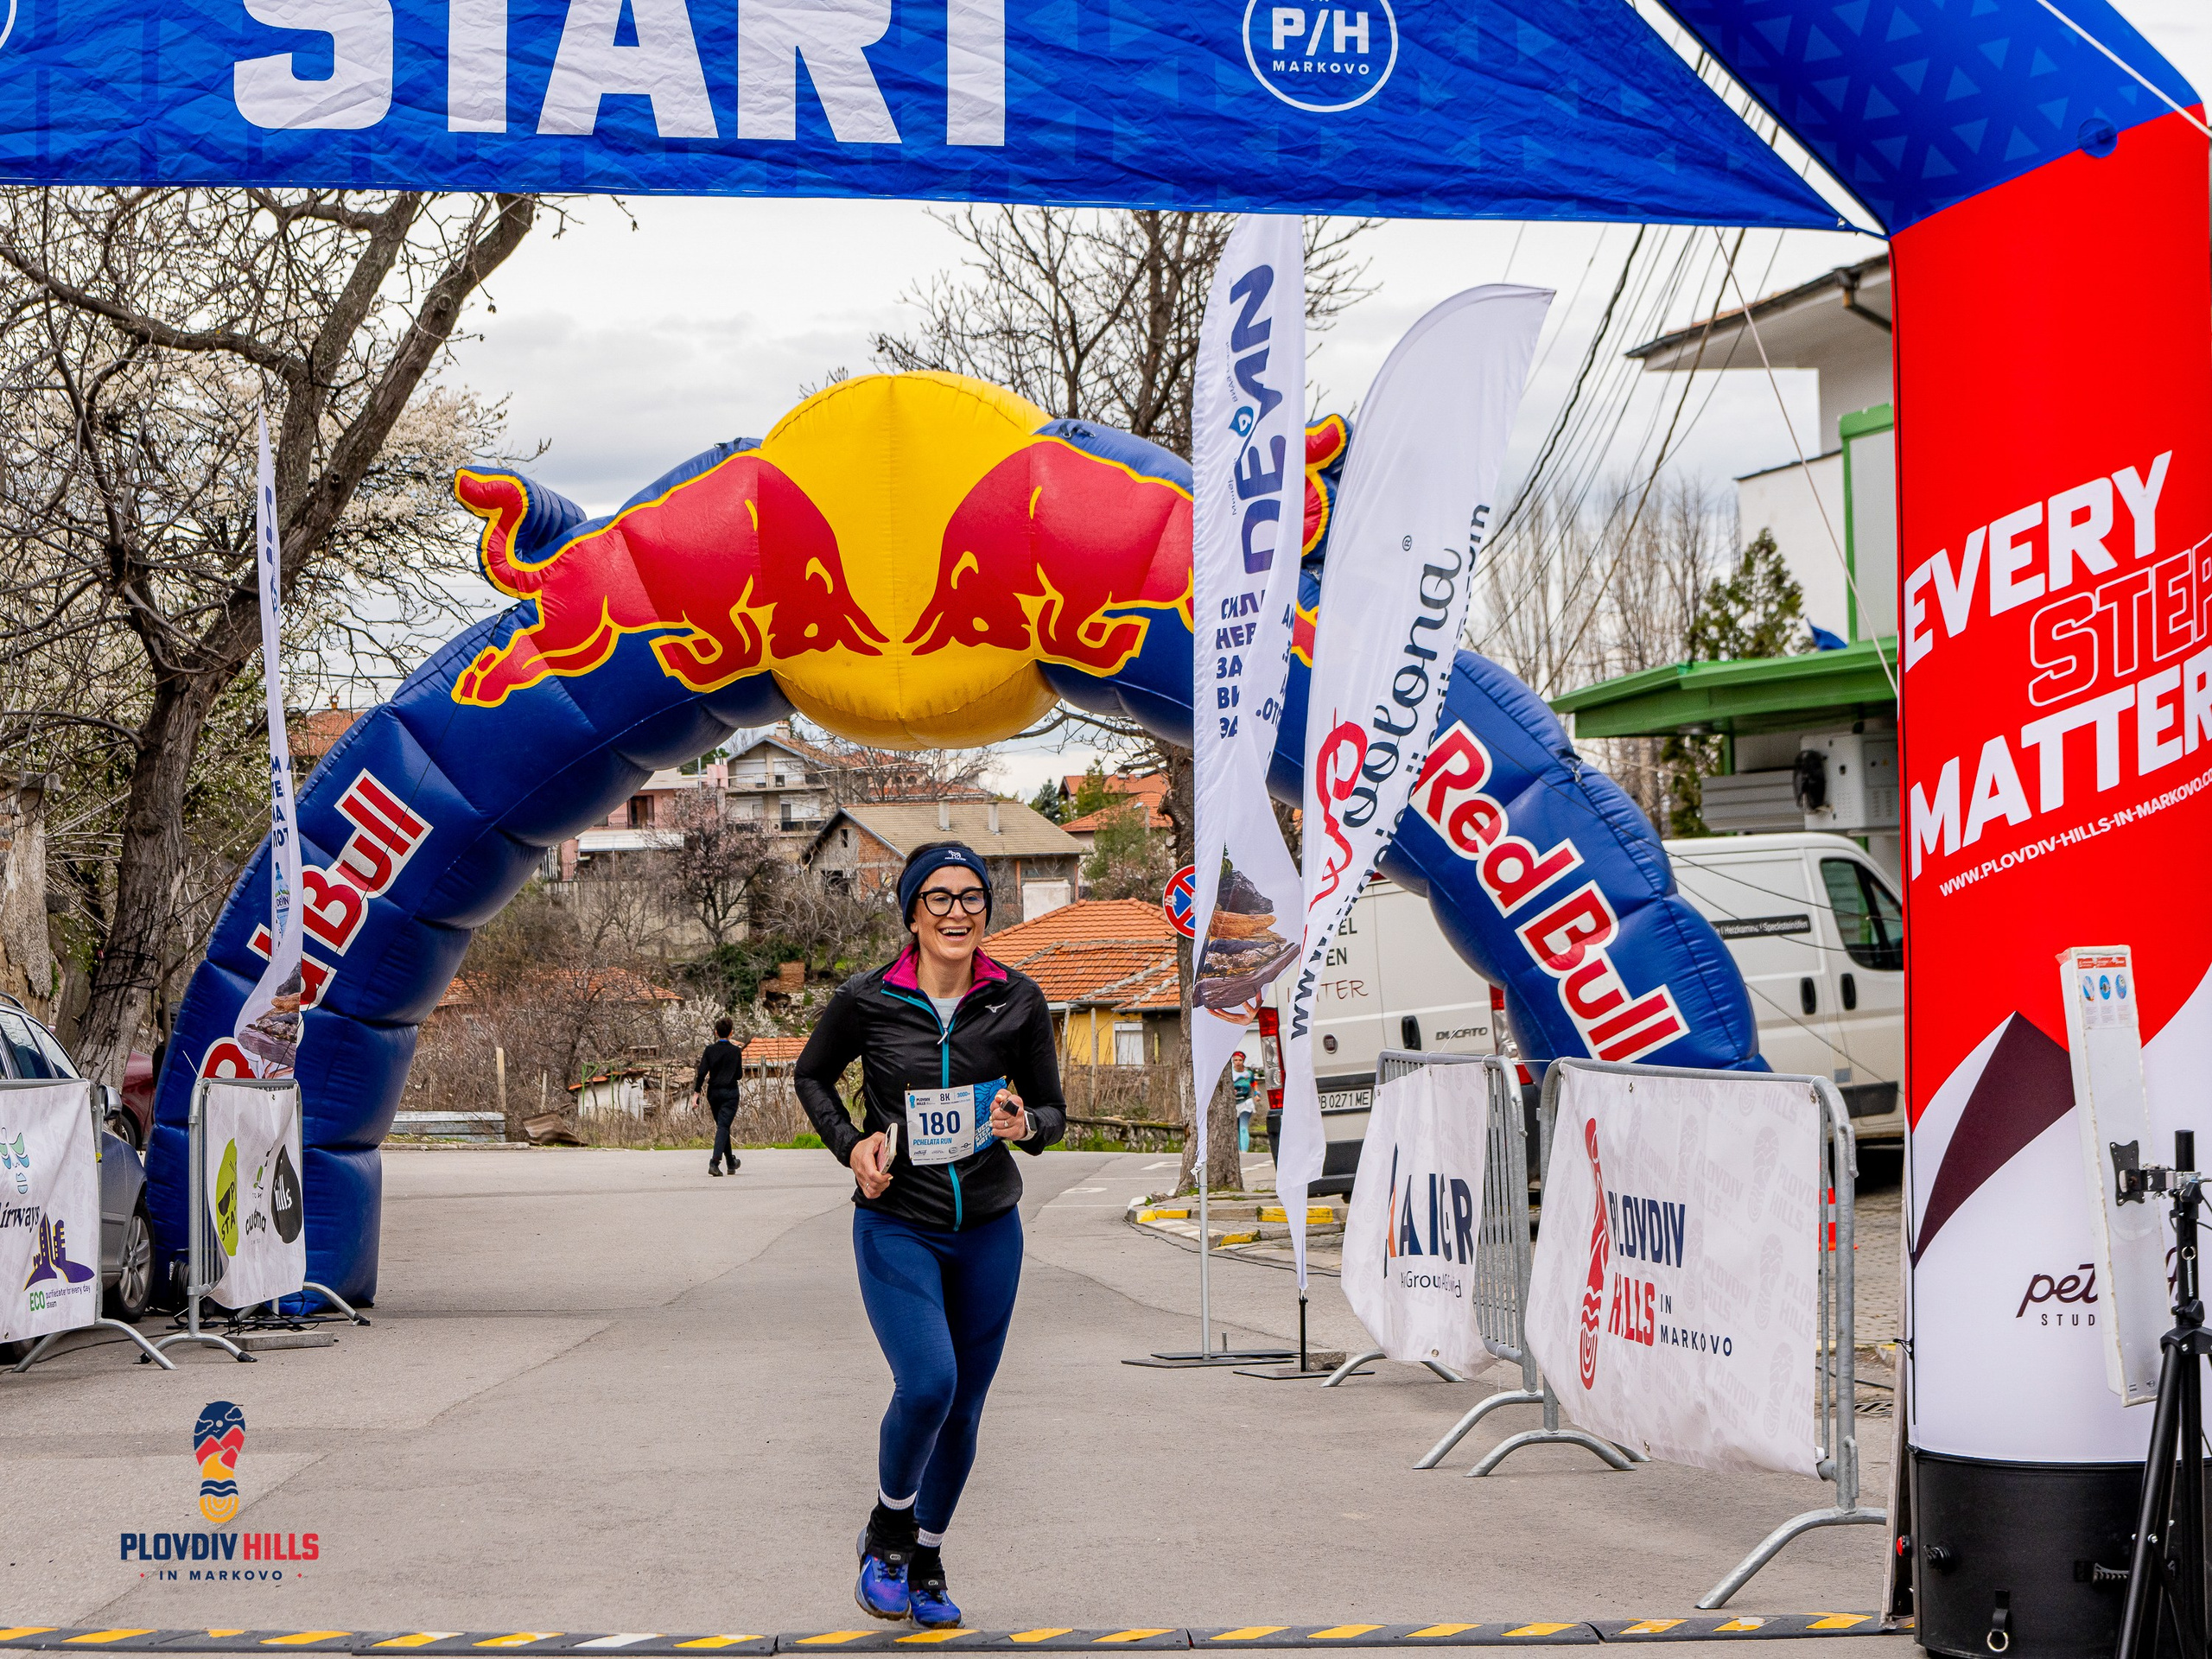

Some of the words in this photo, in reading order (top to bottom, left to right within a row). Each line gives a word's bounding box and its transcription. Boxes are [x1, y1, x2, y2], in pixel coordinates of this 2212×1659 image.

[1272, 7, 1370, 56] P/H
[1273, 60, 1370, 75] MARKOVO
[1904, 450, 2172, 673] EVERY
[302, 776, 426, 949] Bull
[1412, 728, 1575, 909] Red
[1523, 888, 1681, 1062] Bull
[1435, 1027, 1488, 1041] DUCATO
[940, 1092, 950, 1102] 8K
[1329, 1092, 1353, 1108] 0271
[918, 1110, 961, 1136] 180
[0, 1202, 41, 1233] irways
[1608, 1191, 1685, 1268] PLOVDIV
[29, 1290, 45, 1312] ECO
[1608, 1272, 1656, 1347] HILLS
[1661, 1294, 1672, 1314] IN
[2041, 1313, 2095, 1326] STUD
[1661, 1325, 1732, 1357] MARKOVO
